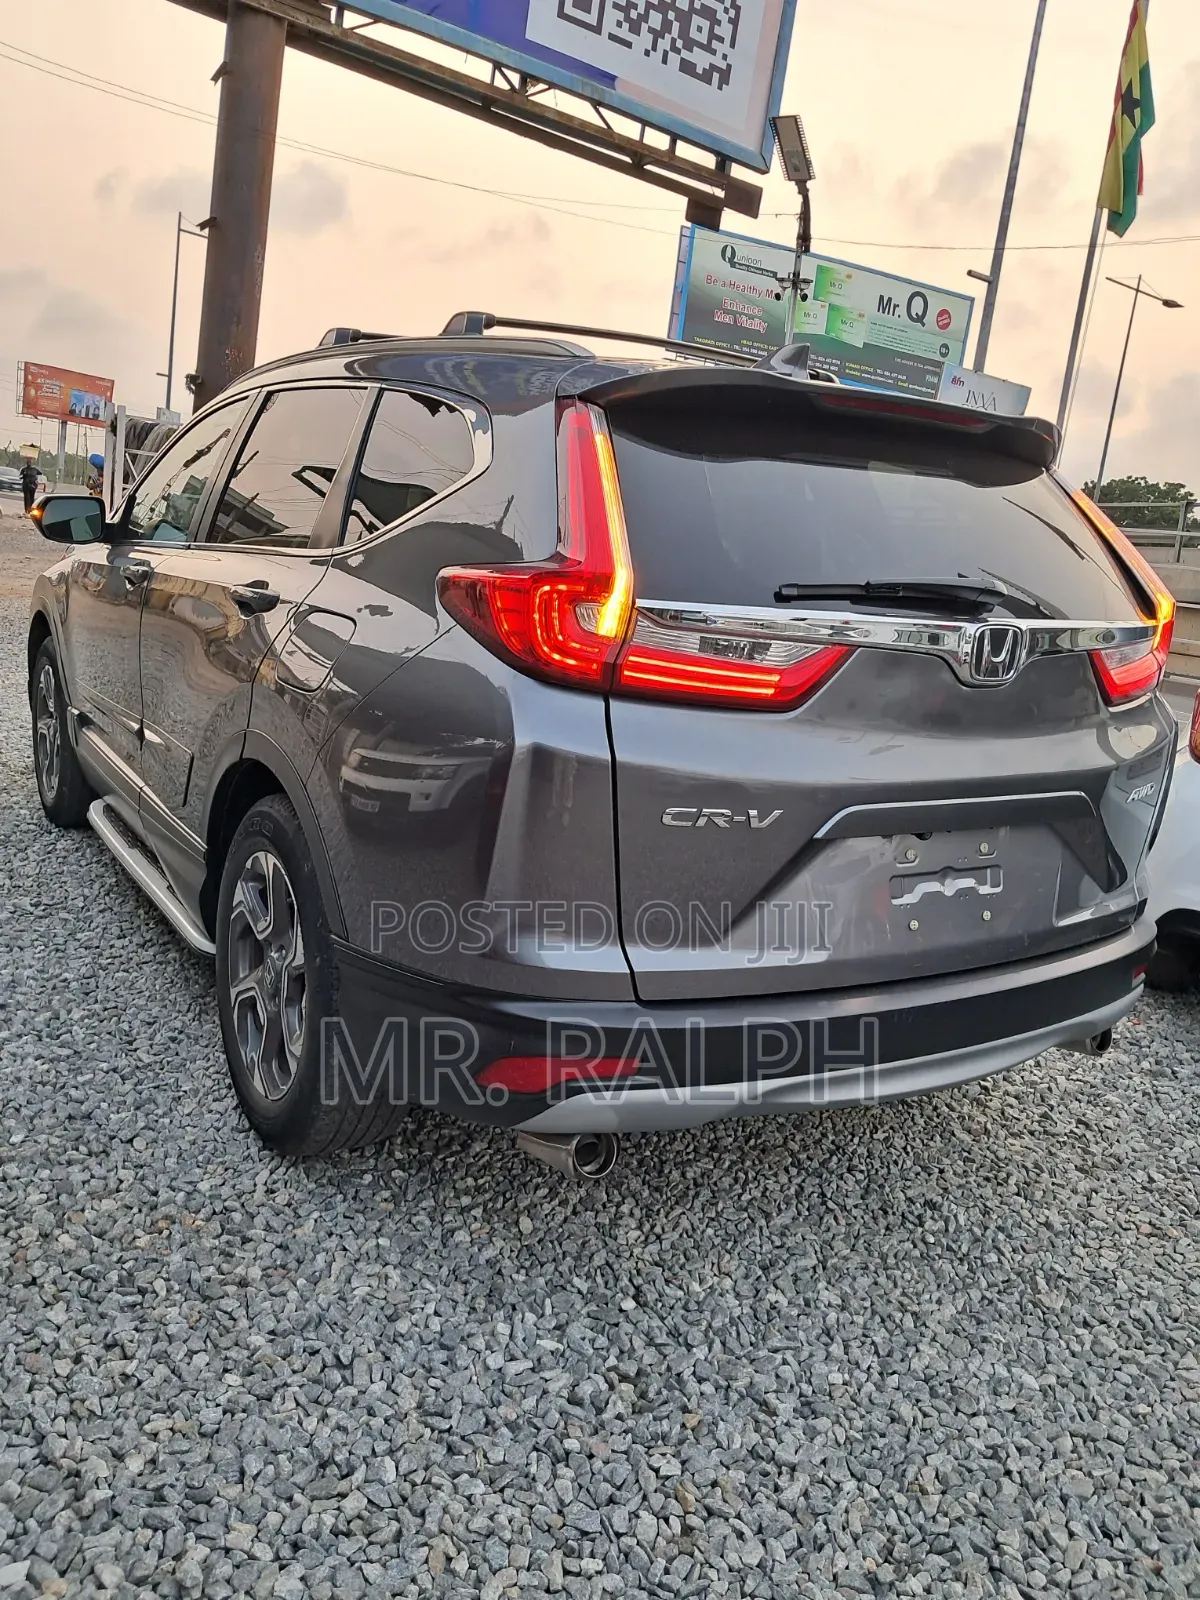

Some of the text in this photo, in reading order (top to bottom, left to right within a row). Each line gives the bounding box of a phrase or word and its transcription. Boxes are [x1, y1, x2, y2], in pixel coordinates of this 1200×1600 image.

[705, 274, 718, 286] Be
[720, 280, 726, 288] a
[729, 279, 763, 298] Healthy
[722, 297, 763, 316] Enhance
[877, 294, 901, 318] Mr.
[906, 290, 929, 328] Q
[713, 309, 768, 333] Men Vitality
[716, 340, 730, 349] OFFICE
[1126, 782, 1155, 803] AWD
[661, 807, 784, 828] CR-V
